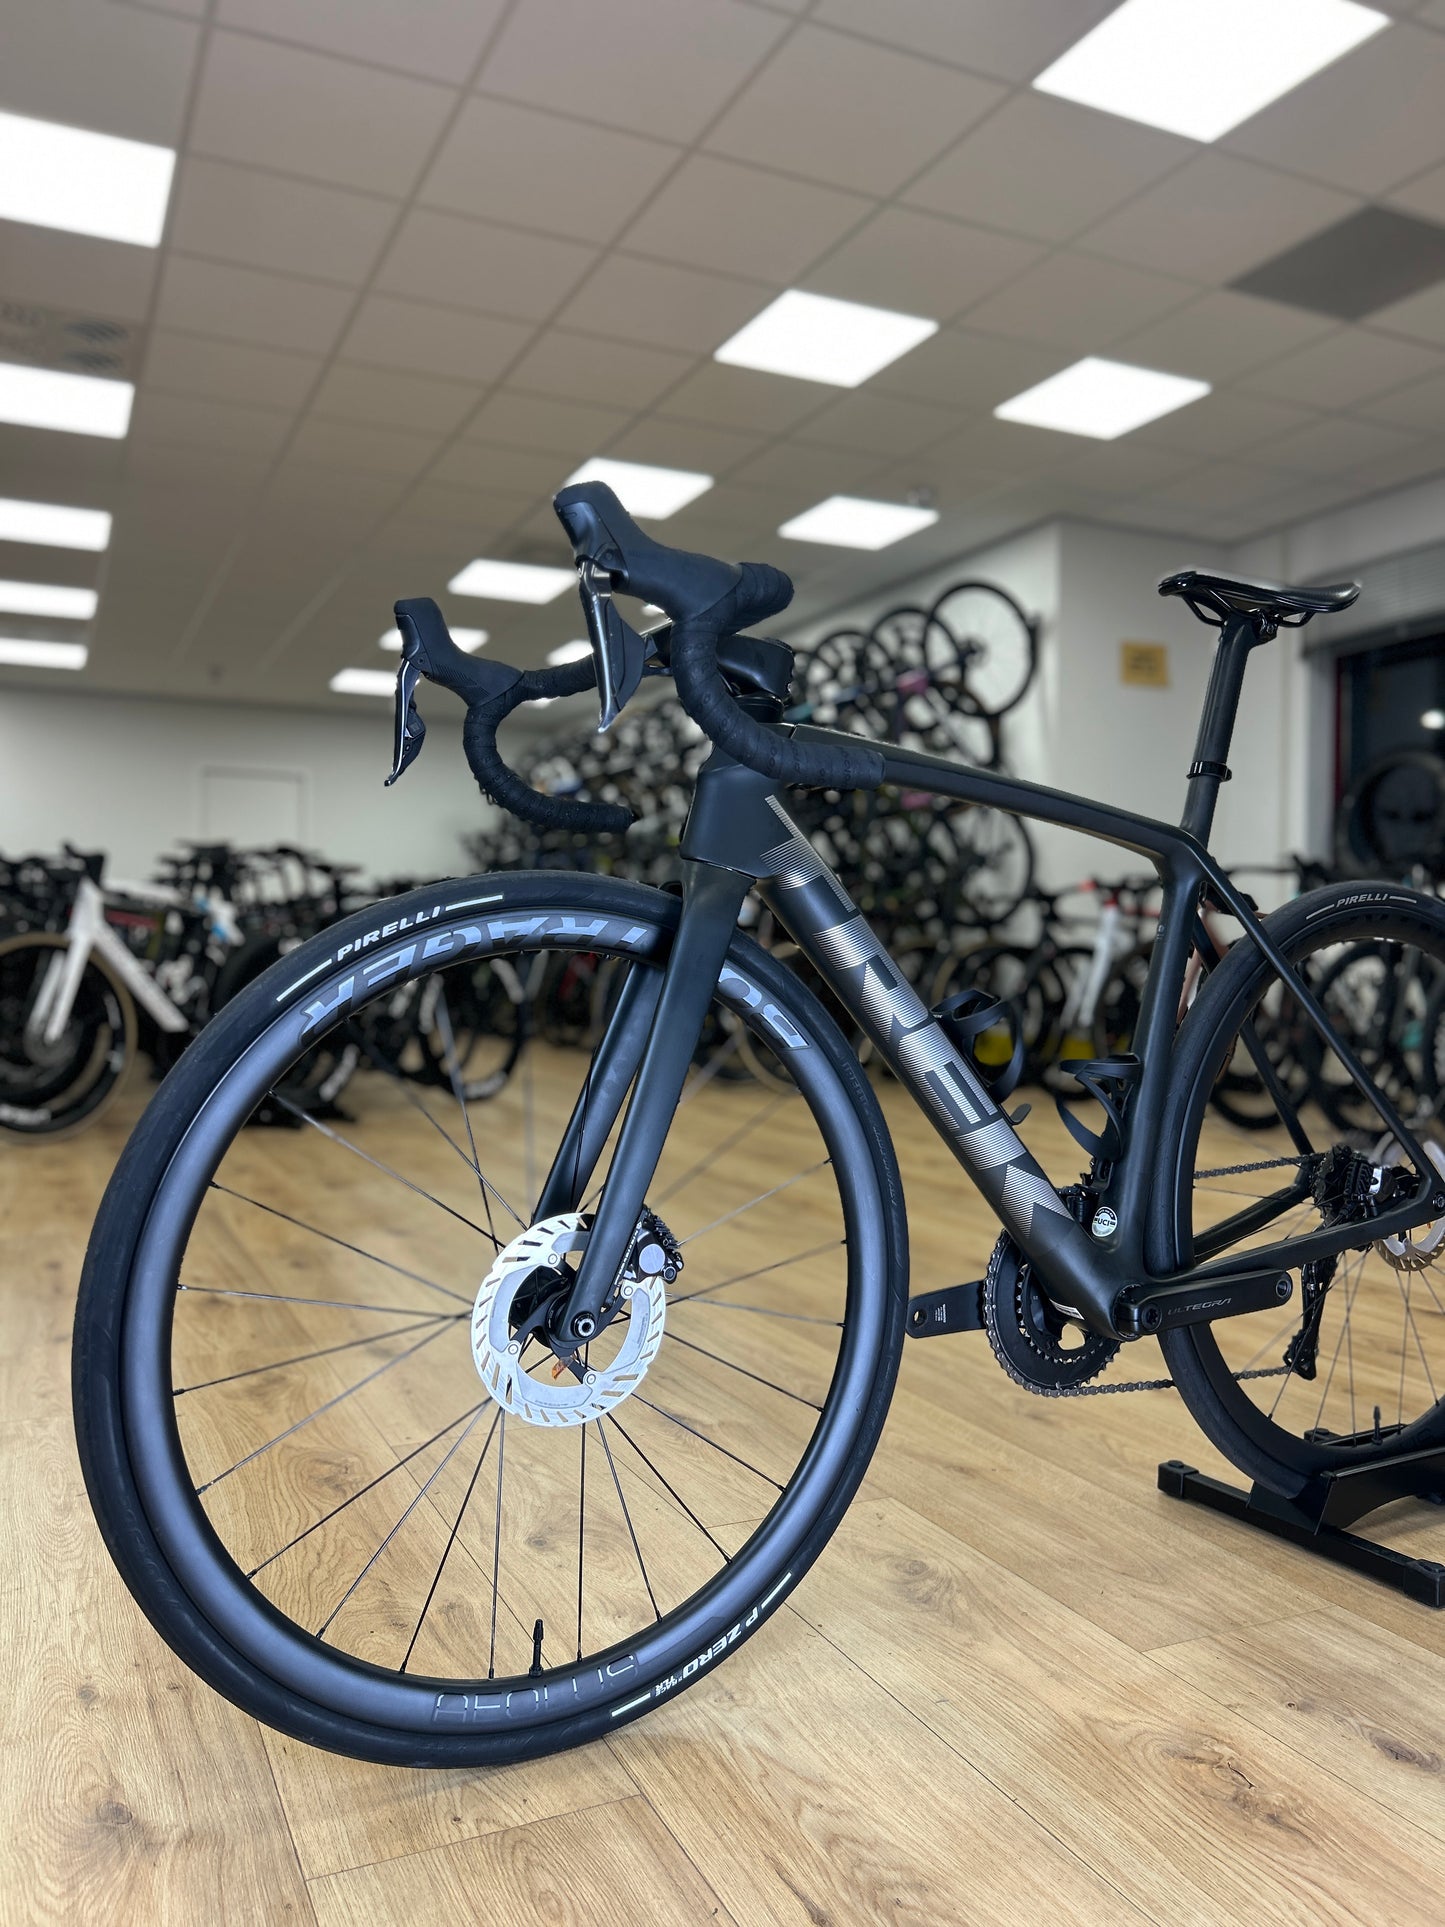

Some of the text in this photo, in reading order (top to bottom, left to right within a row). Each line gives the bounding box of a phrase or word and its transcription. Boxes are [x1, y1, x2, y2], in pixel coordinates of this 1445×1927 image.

[1336, 893, 1388, 907] PIRELLI
[337, 906, 441, 961] PIRELLI
[760, 794, 1076, 1238] TREK
[1167, 1297, 1232, 1315] ULTEGRA
[745, 1606, 759, 1627] P
[682, 1623, 741, 1679] ZERO
